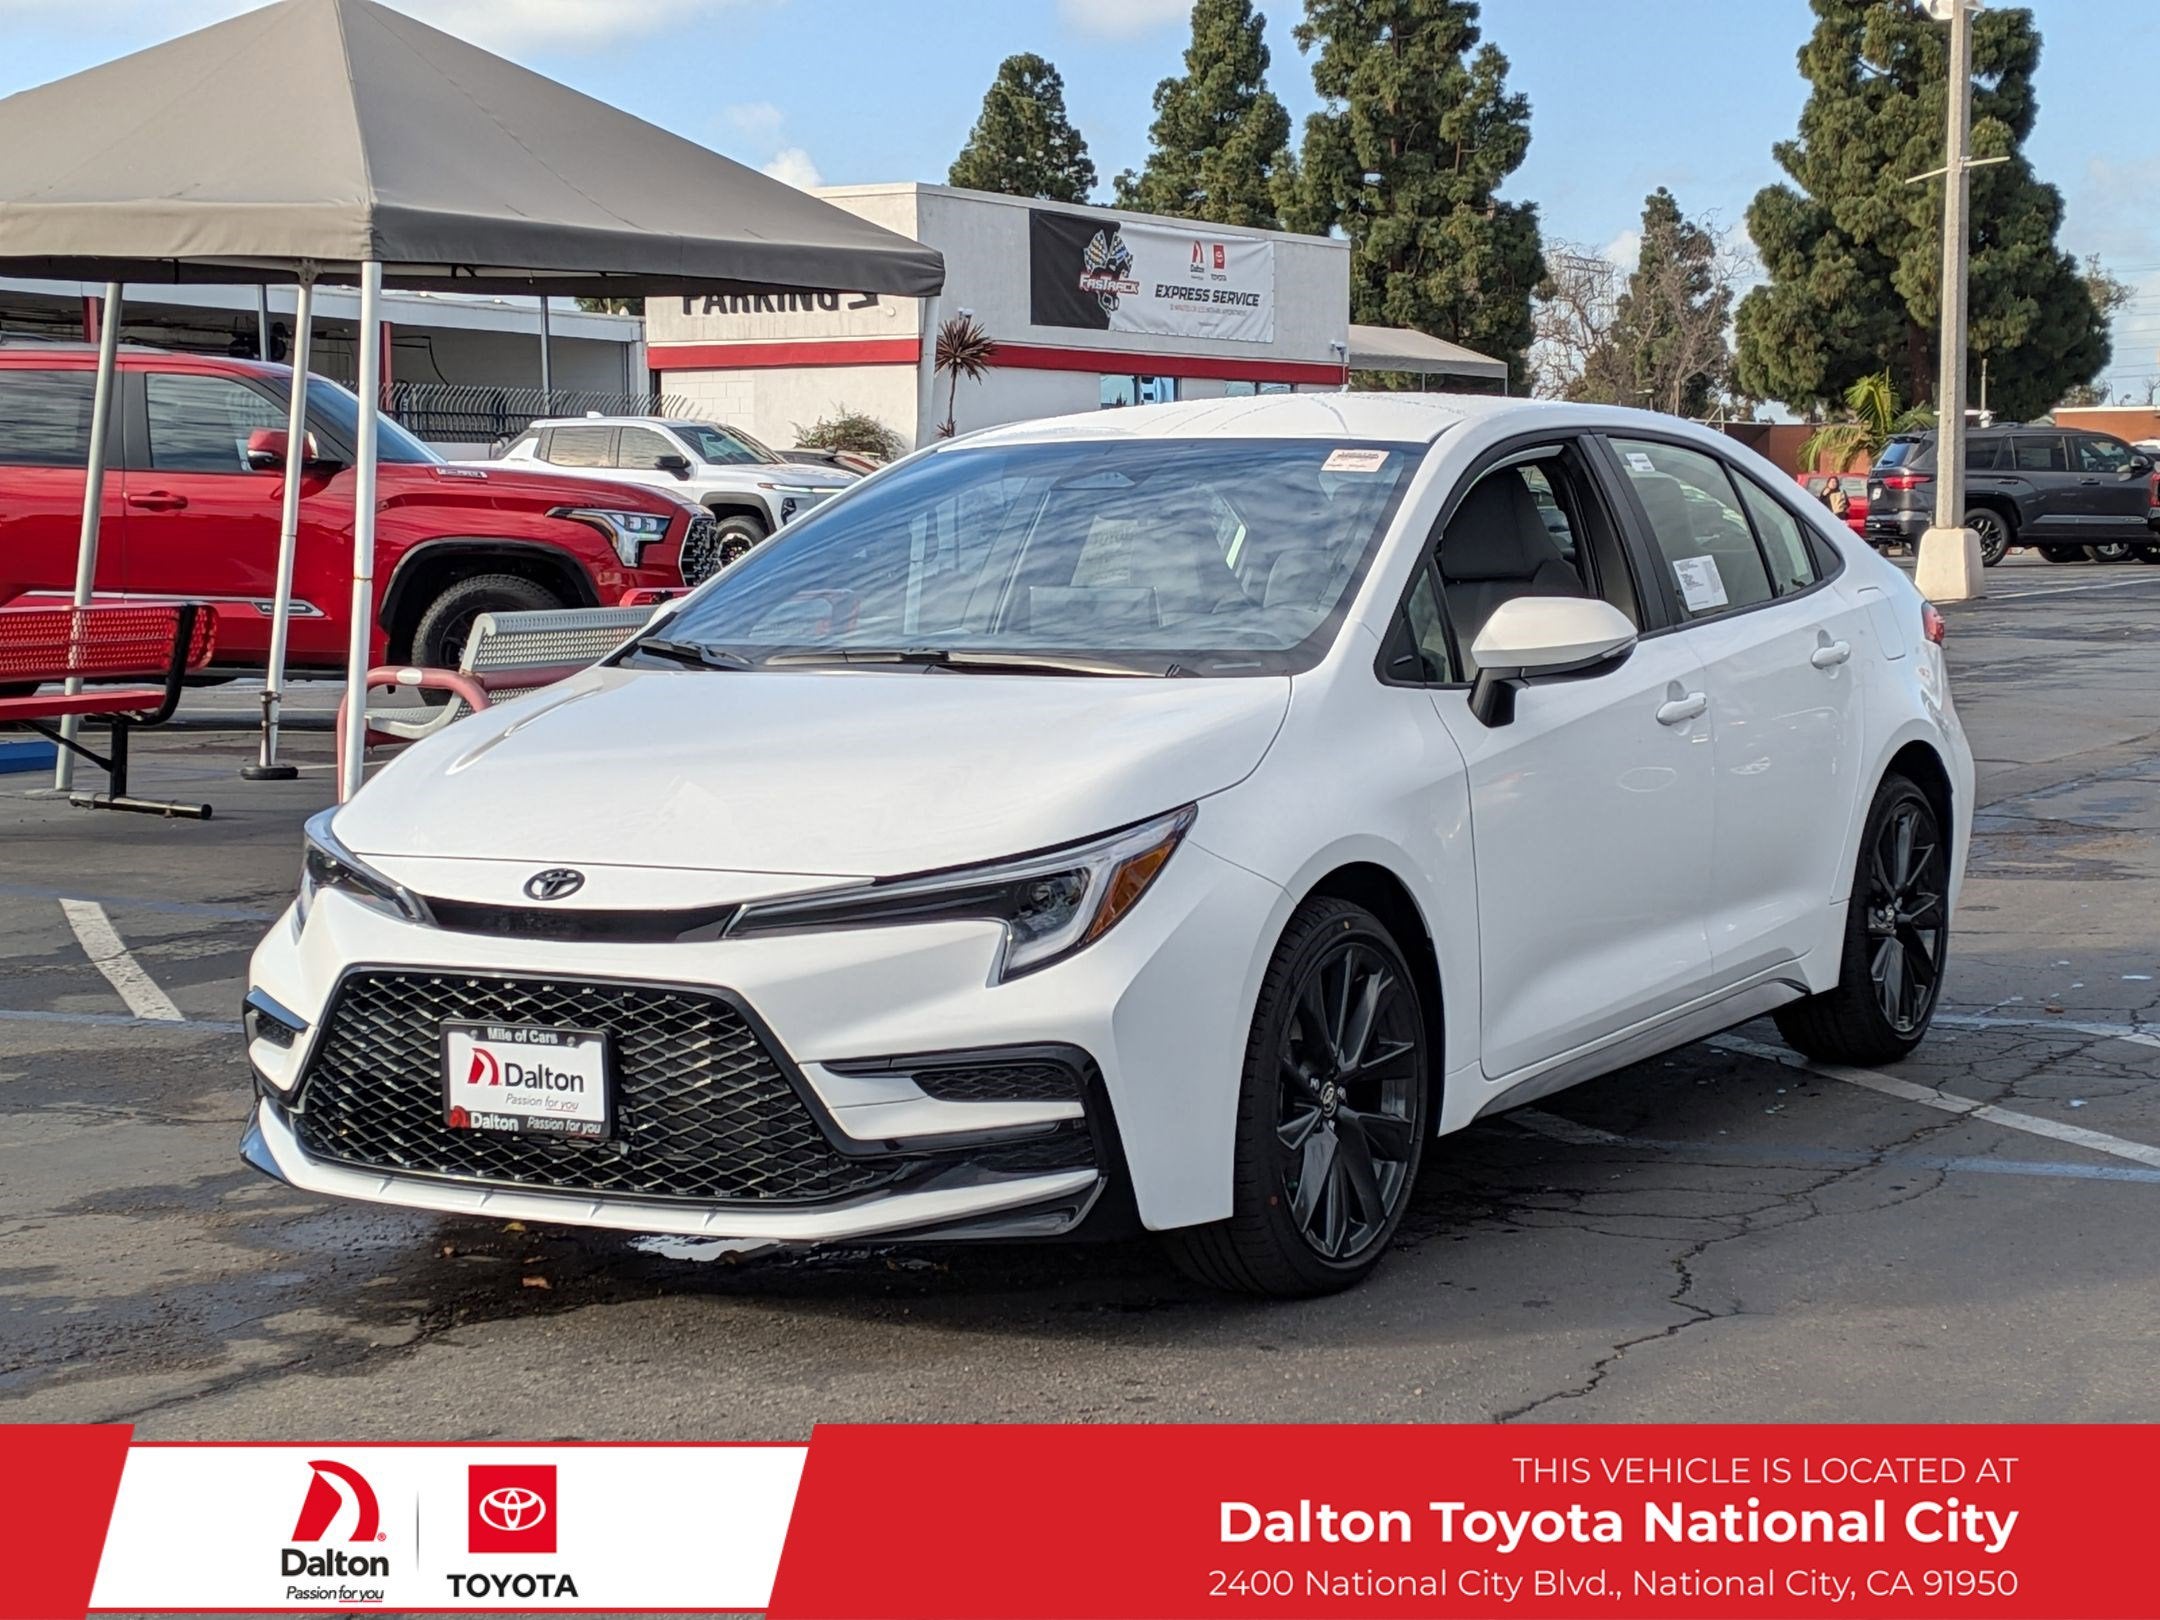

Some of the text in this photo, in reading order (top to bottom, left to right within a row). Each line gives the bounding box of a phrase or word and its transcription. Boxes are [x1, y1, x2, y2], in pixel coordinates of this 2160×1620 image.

[1155, 284, 1260, 307] EXPRESS SERVICE
[487, 1027, 558, 1044] Mile of Cars
[504, 1062, 584, 1093] Dalton
[505, 1093, 580, 1110] Passion for you
[470, 1112, 601, 1135] Dalton Passion for you
